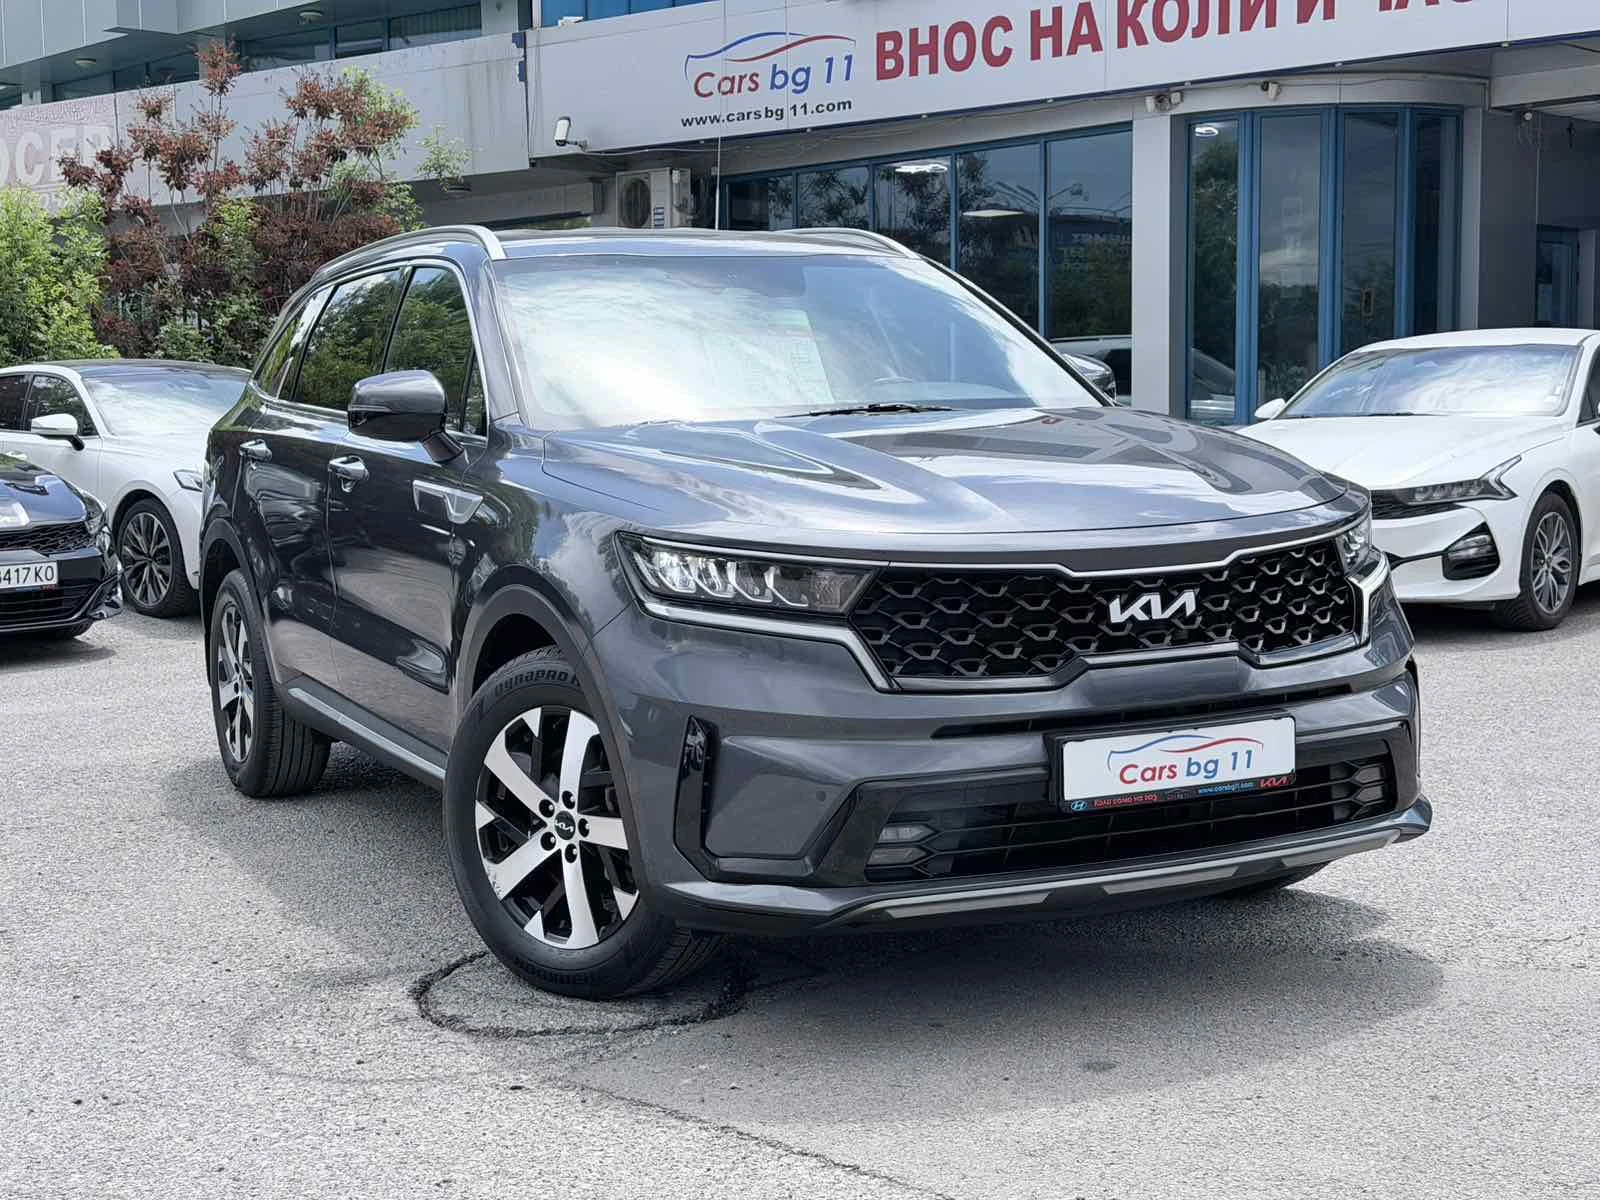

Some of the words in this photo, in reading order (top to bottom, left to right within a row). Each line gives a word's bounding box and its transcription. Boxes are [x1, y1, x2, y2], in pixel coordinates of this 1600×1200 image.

[876, 16, 1013, 81] ВНОС
[1030, 1, 1103, 61] НА
[1117, 0, 1277, 49] КОЛИ
[693, 71, 760, 98] Cars
[770, 63, 811, 95] bg
[824, 54, 853, 84] 11
[1109, 590, 1195, 623] KIA
[1119, 763, 1177, 785] Cars
[1186, 757, 1219, 779] bg
[1231, 749, 1253, 771] 11
